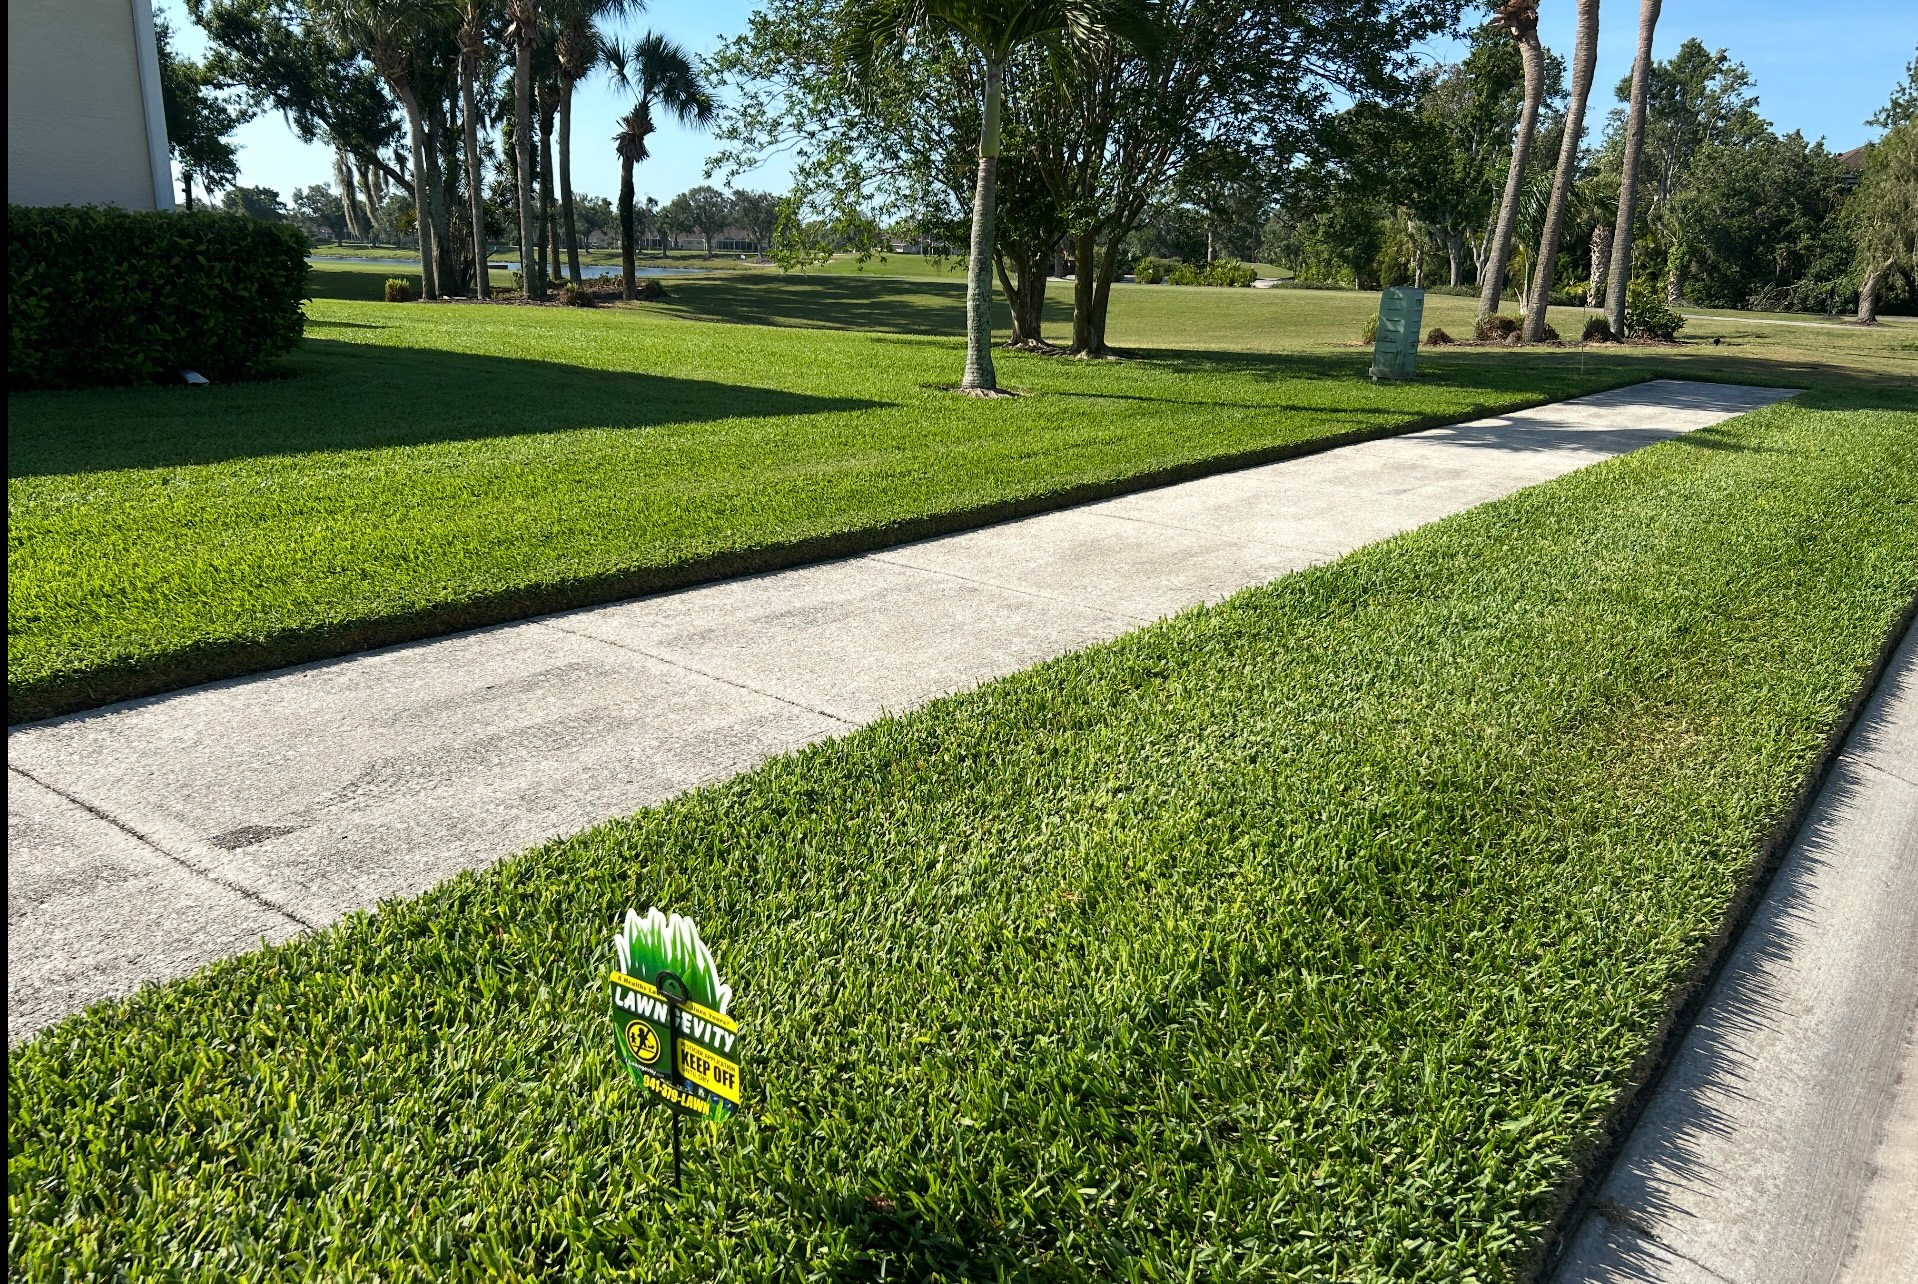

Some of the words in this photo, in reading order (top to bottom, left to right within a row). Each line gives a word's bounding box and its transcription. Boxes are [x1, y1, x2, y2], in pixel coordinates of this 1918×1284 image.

[681, 1049, 710, 1076] KEEP
[714, 1066, 736, 1090] OFF
[682, 1064, 697, 1079] UNTIL
[698, 1073, 710, 1084] DRY
[705, 1053, 736, 1073] APPLICATION
[643, 1074, 710, 1116] 941-379-LAWN
